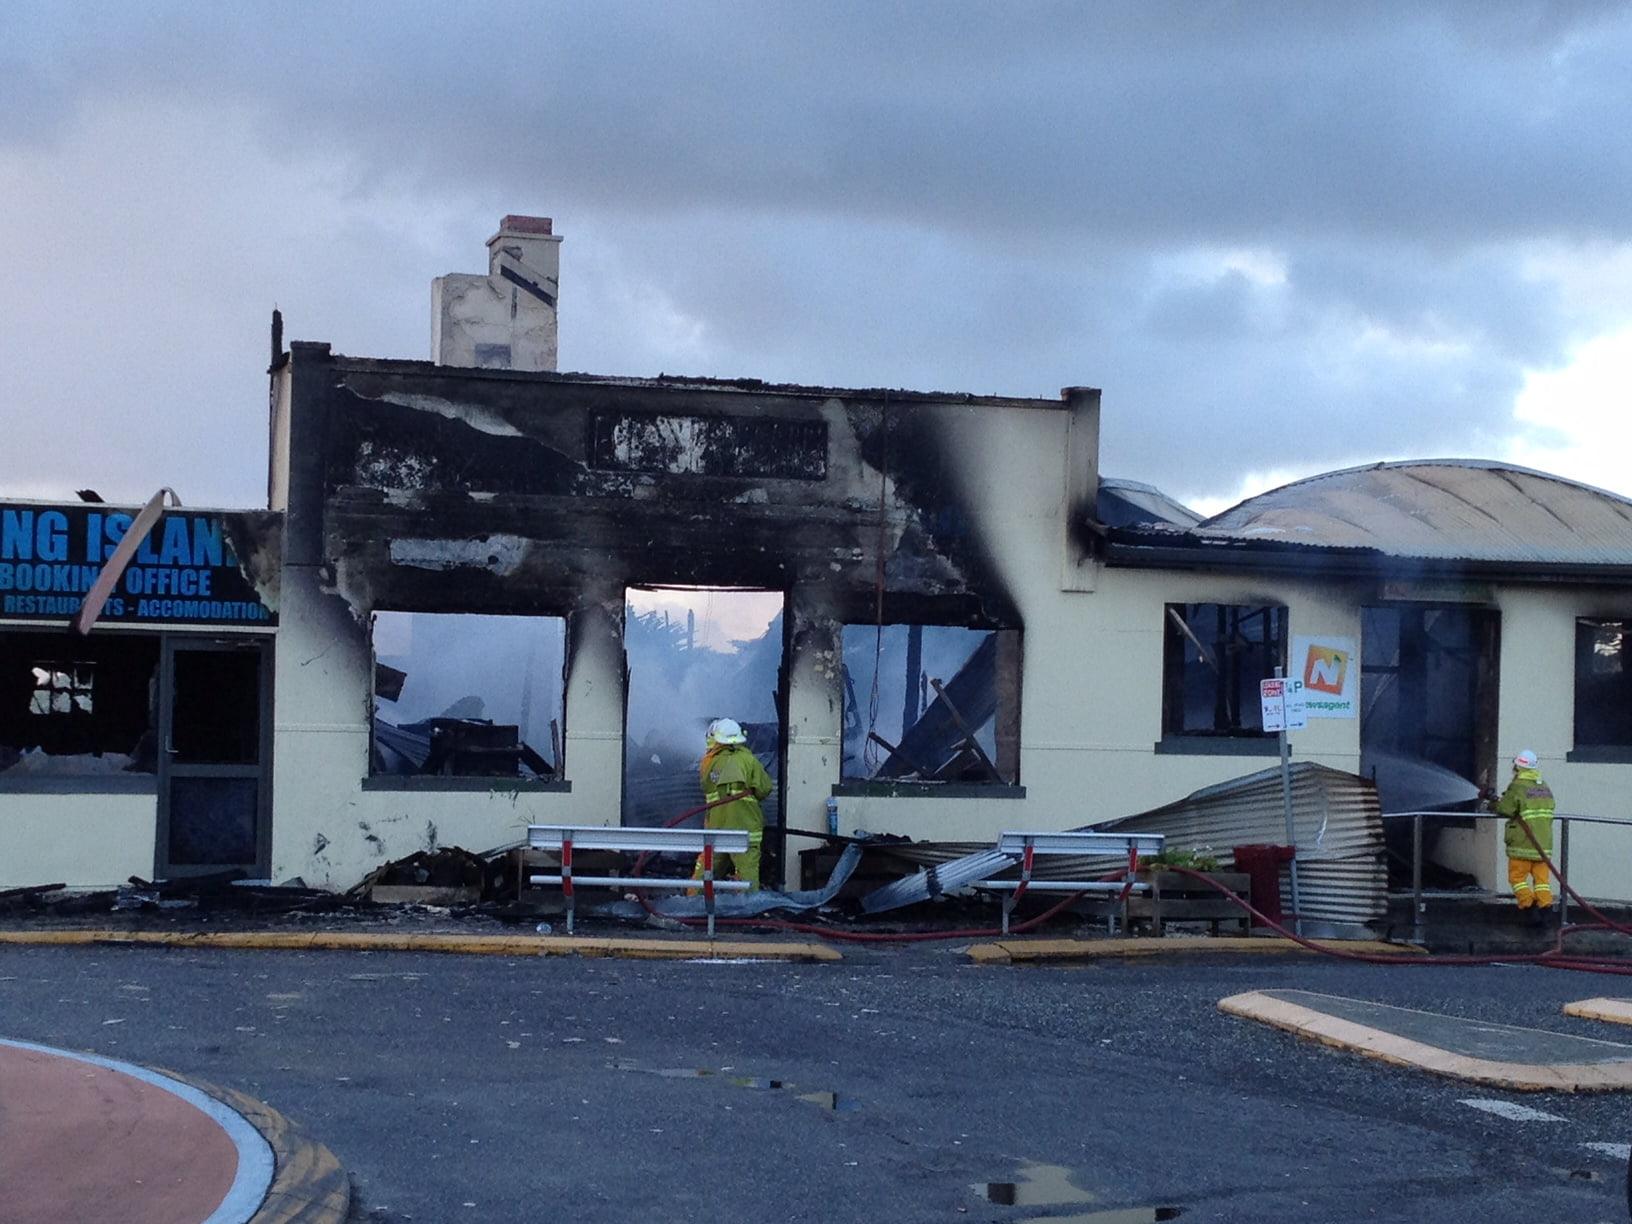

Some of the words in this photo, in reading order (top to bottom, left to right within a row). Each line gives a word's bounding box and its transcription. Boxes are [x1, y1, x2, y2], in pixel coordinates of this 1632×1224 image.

[1, 509, 69, 561] NG
[86, 512, 238, 568] ISLAN
[0, 562, 116, 593] BOOKIN
[126, 566, 212, 597] OFFICE
[4, 594, 124, 617] RESTAURTS
